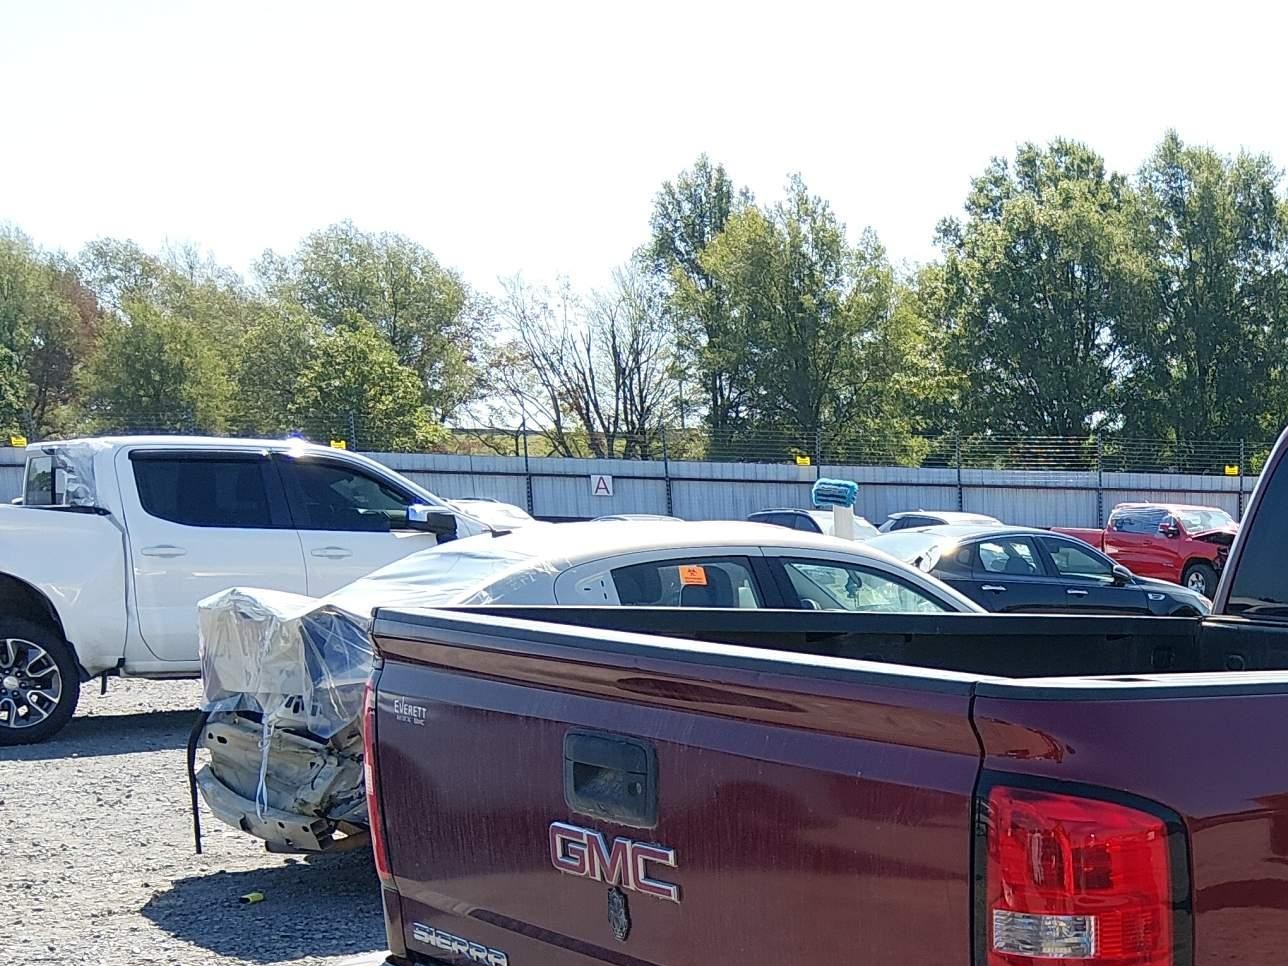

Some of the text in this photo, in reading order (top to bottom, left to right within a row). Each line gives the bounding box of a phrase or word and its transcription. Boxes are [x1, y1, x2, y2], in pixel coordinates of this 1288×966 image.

[594, 476, 610, 494] A
[394, 696, 427, 719] EVERETT
[549, 821, 681, 904] GMC
